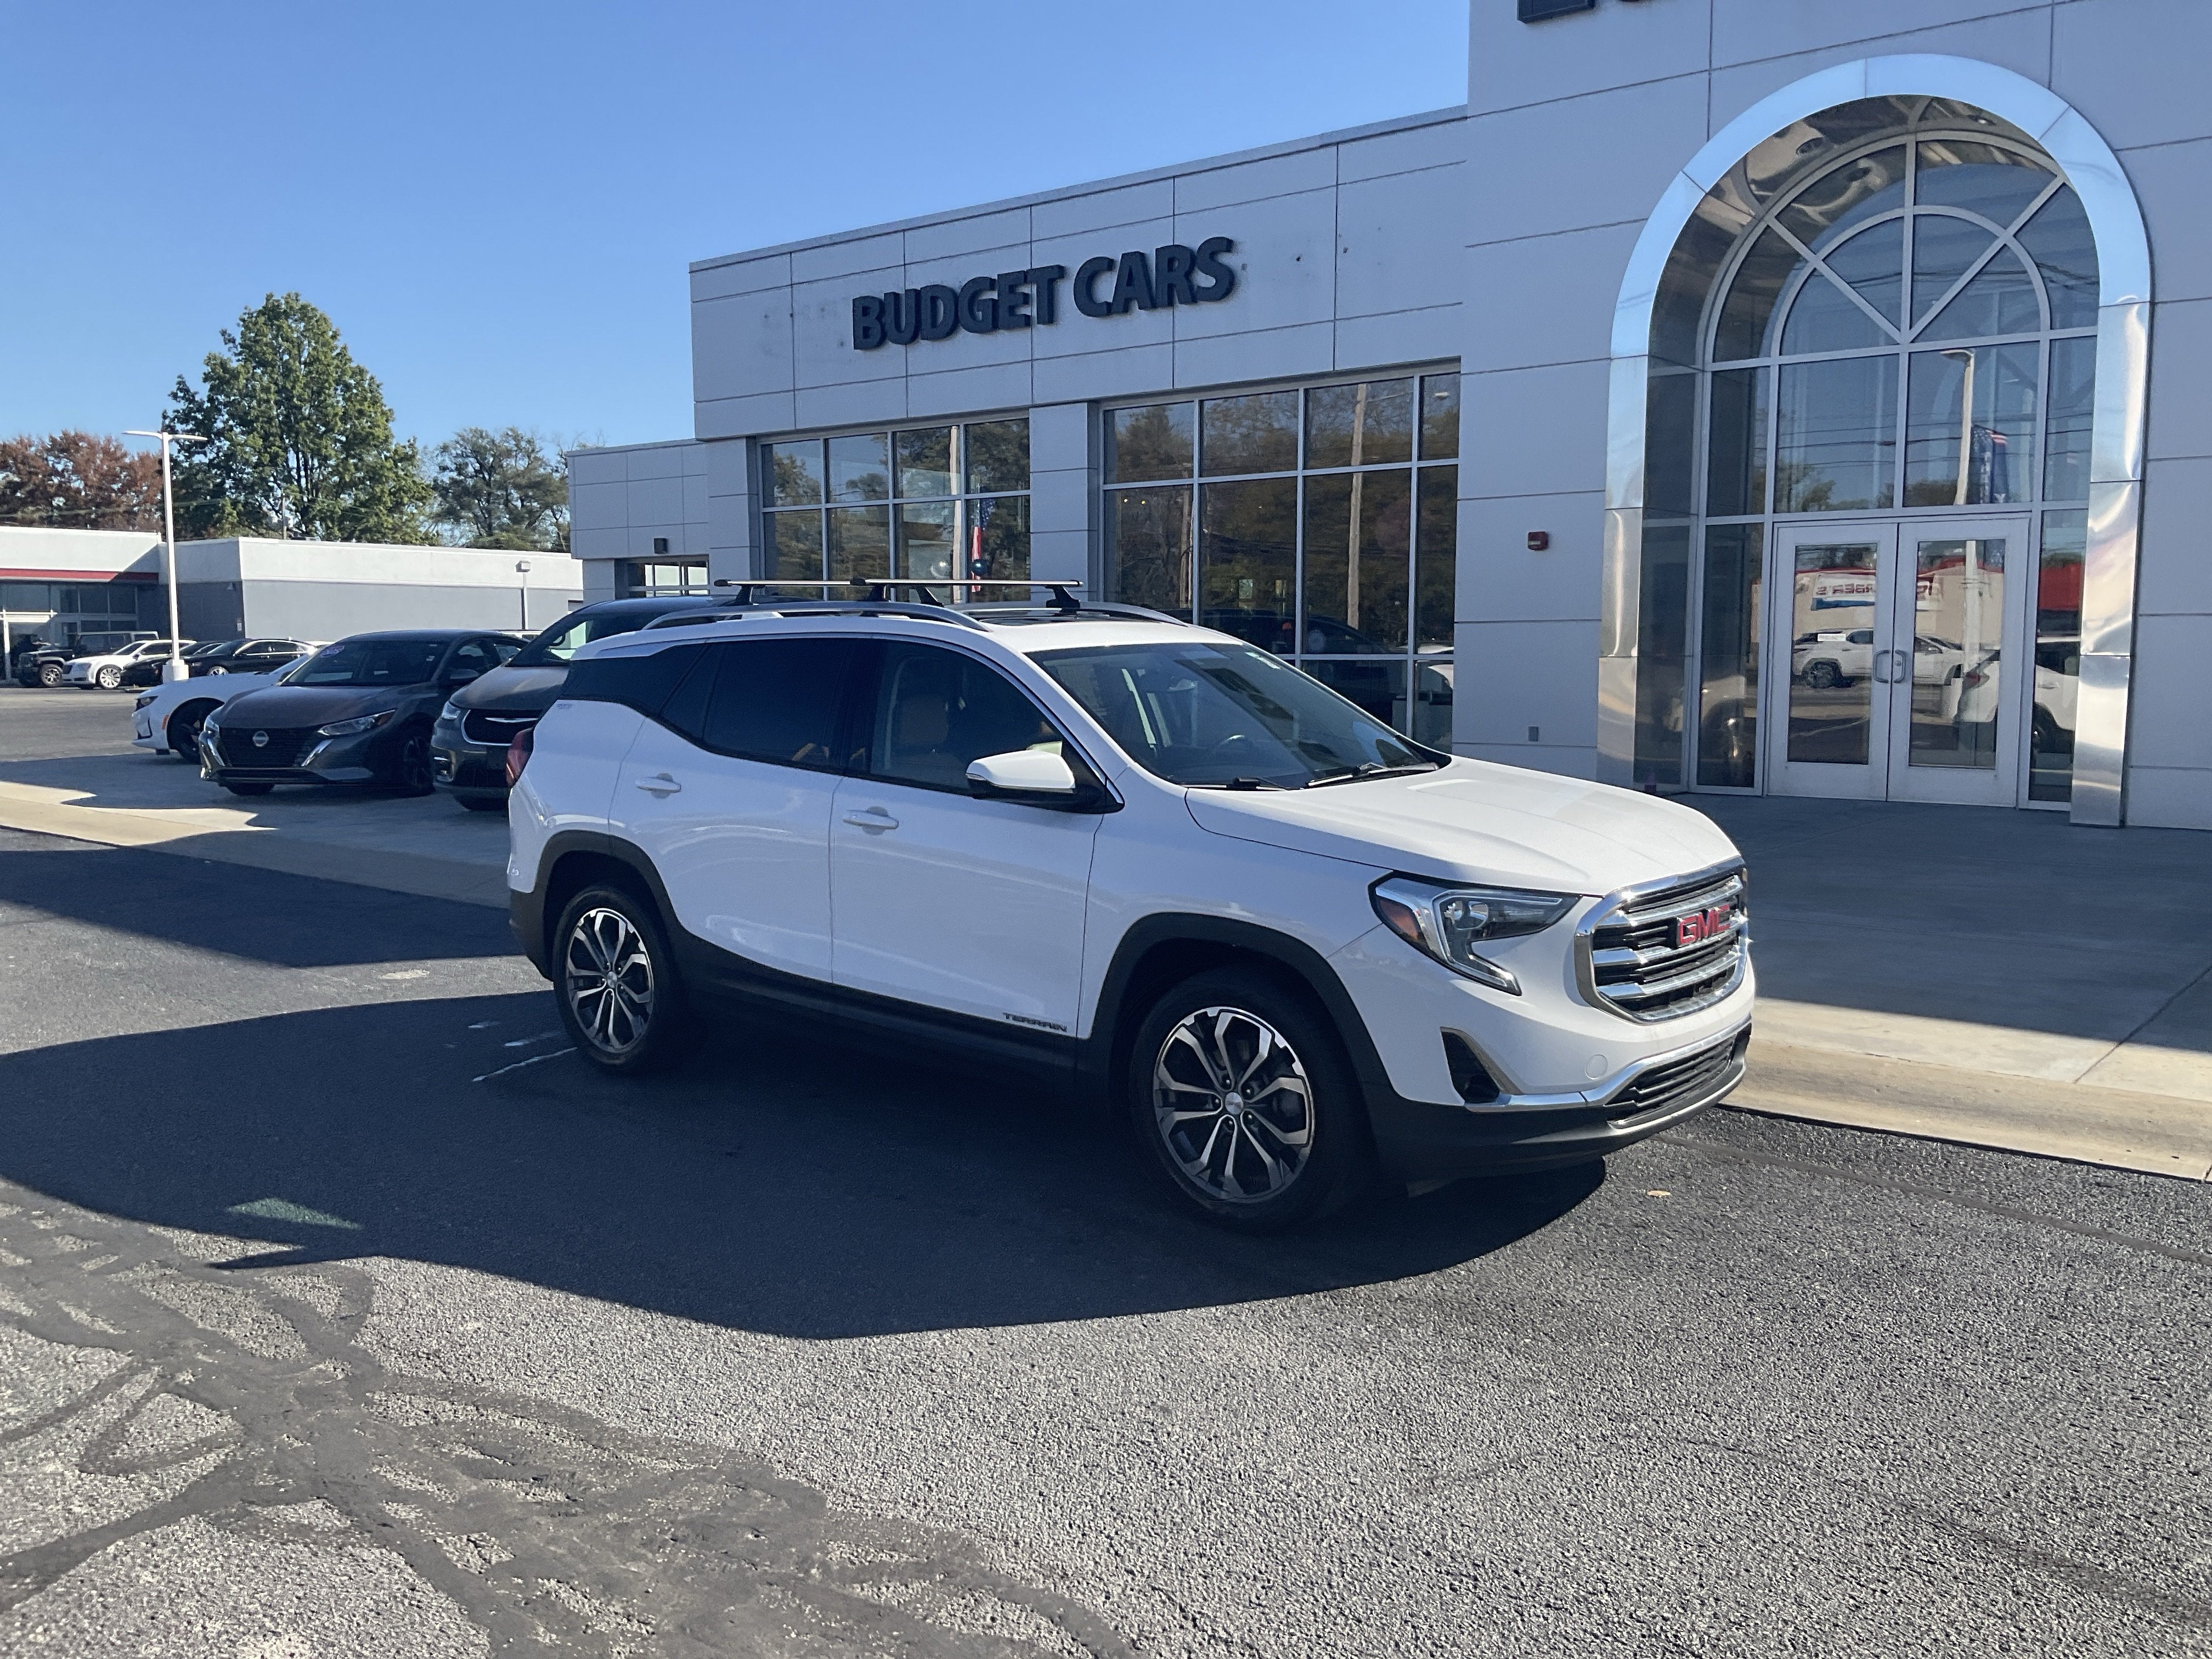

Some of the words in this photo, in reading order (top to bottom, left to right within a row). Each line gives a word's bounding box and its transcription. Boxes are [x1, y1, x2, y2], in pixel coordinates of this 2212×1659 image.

[853, 264, 1065, 351] BUDGET
[1073, 236, 1237, 318] CARS
[1679, 904, 1730, 944] GMC
[1002, 1012, 1067, 1032] TERRAIN
